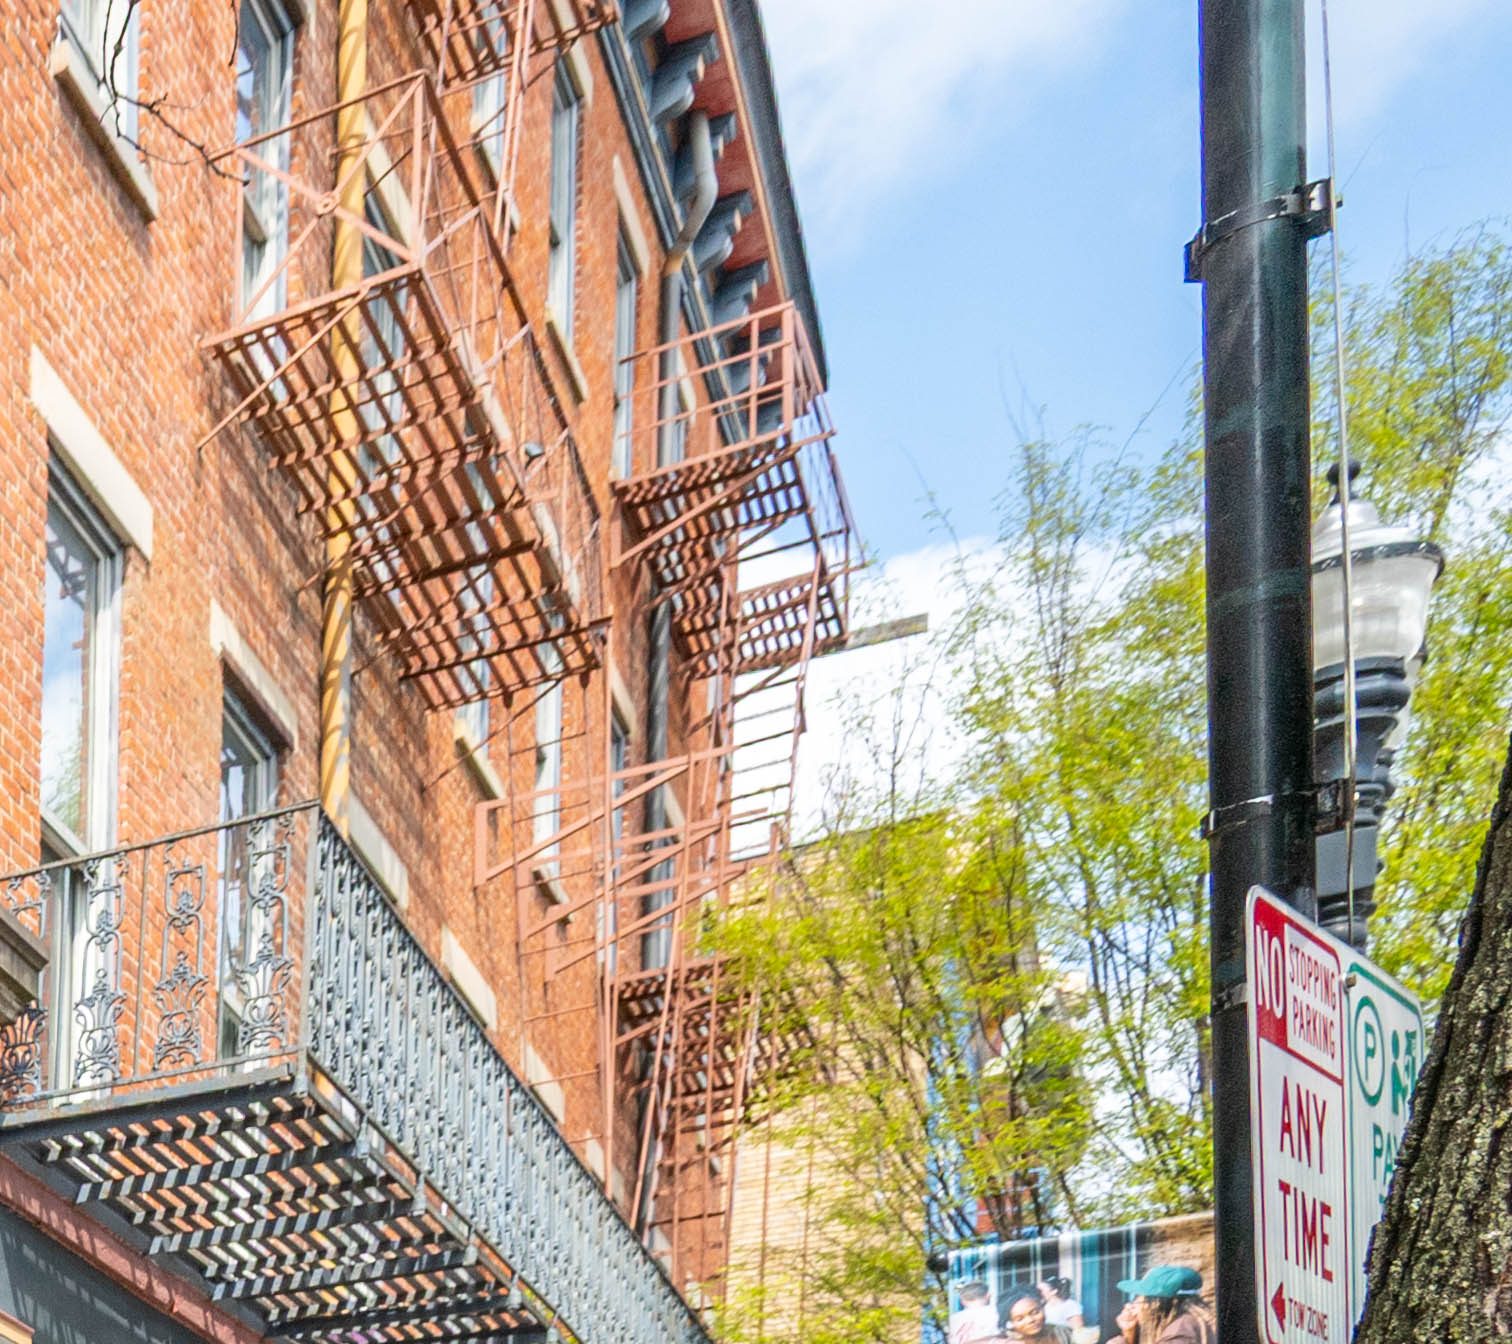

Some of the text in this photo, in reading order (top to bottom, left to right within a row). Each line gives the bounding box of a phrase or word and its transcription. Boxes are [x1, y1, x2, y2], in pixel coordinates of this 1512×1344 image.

[1256, 924, 1285, 1020] NO
[1289, 944, 1336, 1011] STOPPING
[1292, 995, 1335, 1060] PARKING
[1280, 1075, 1327, 1175] ANY
[1279, 1179, 1333, 1284] TIME
[1289, 1297, 1329, 1341] TOW ZONE
